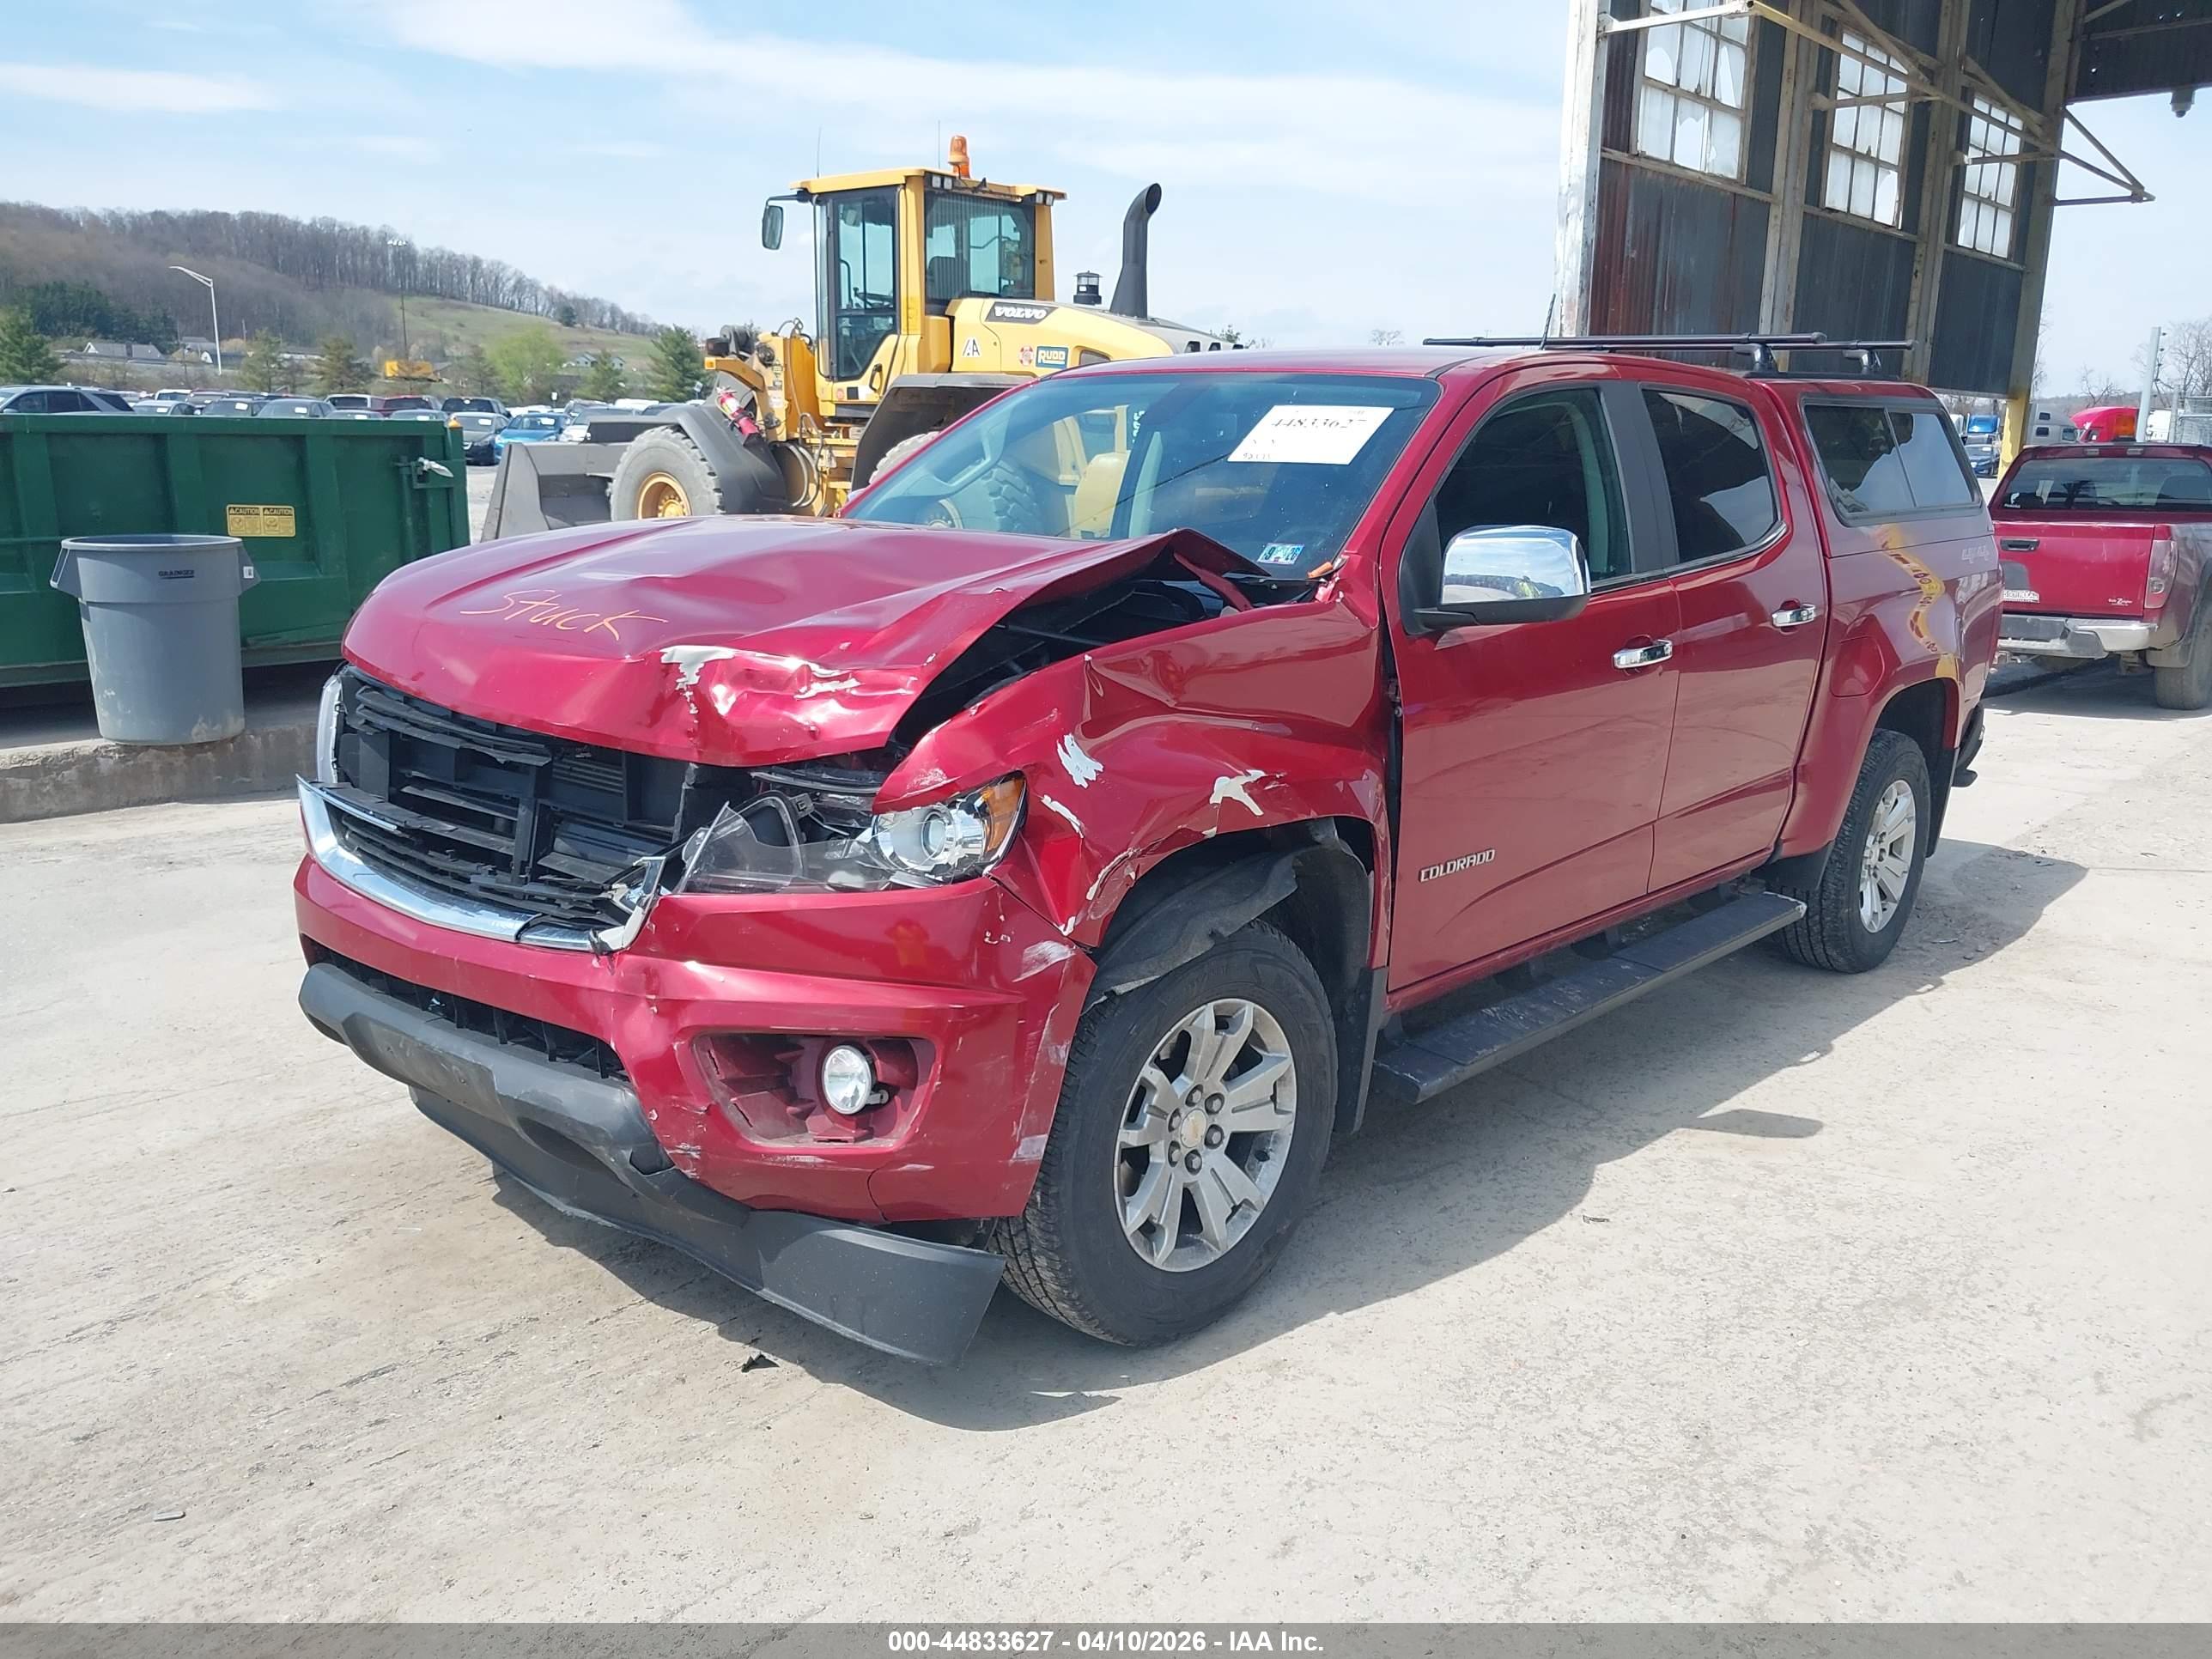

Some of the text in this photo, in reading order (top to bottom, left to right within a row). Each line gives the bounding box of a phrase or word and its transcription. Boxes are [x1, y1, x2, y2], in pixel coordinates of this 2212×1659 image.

[994, 306, 1047, 319] VOLVO
[1037, 349, 1066, 364] RUDD
[1961, 544, 1990, 564] 44
[1418, 848, 1496, 883] COLORADO
